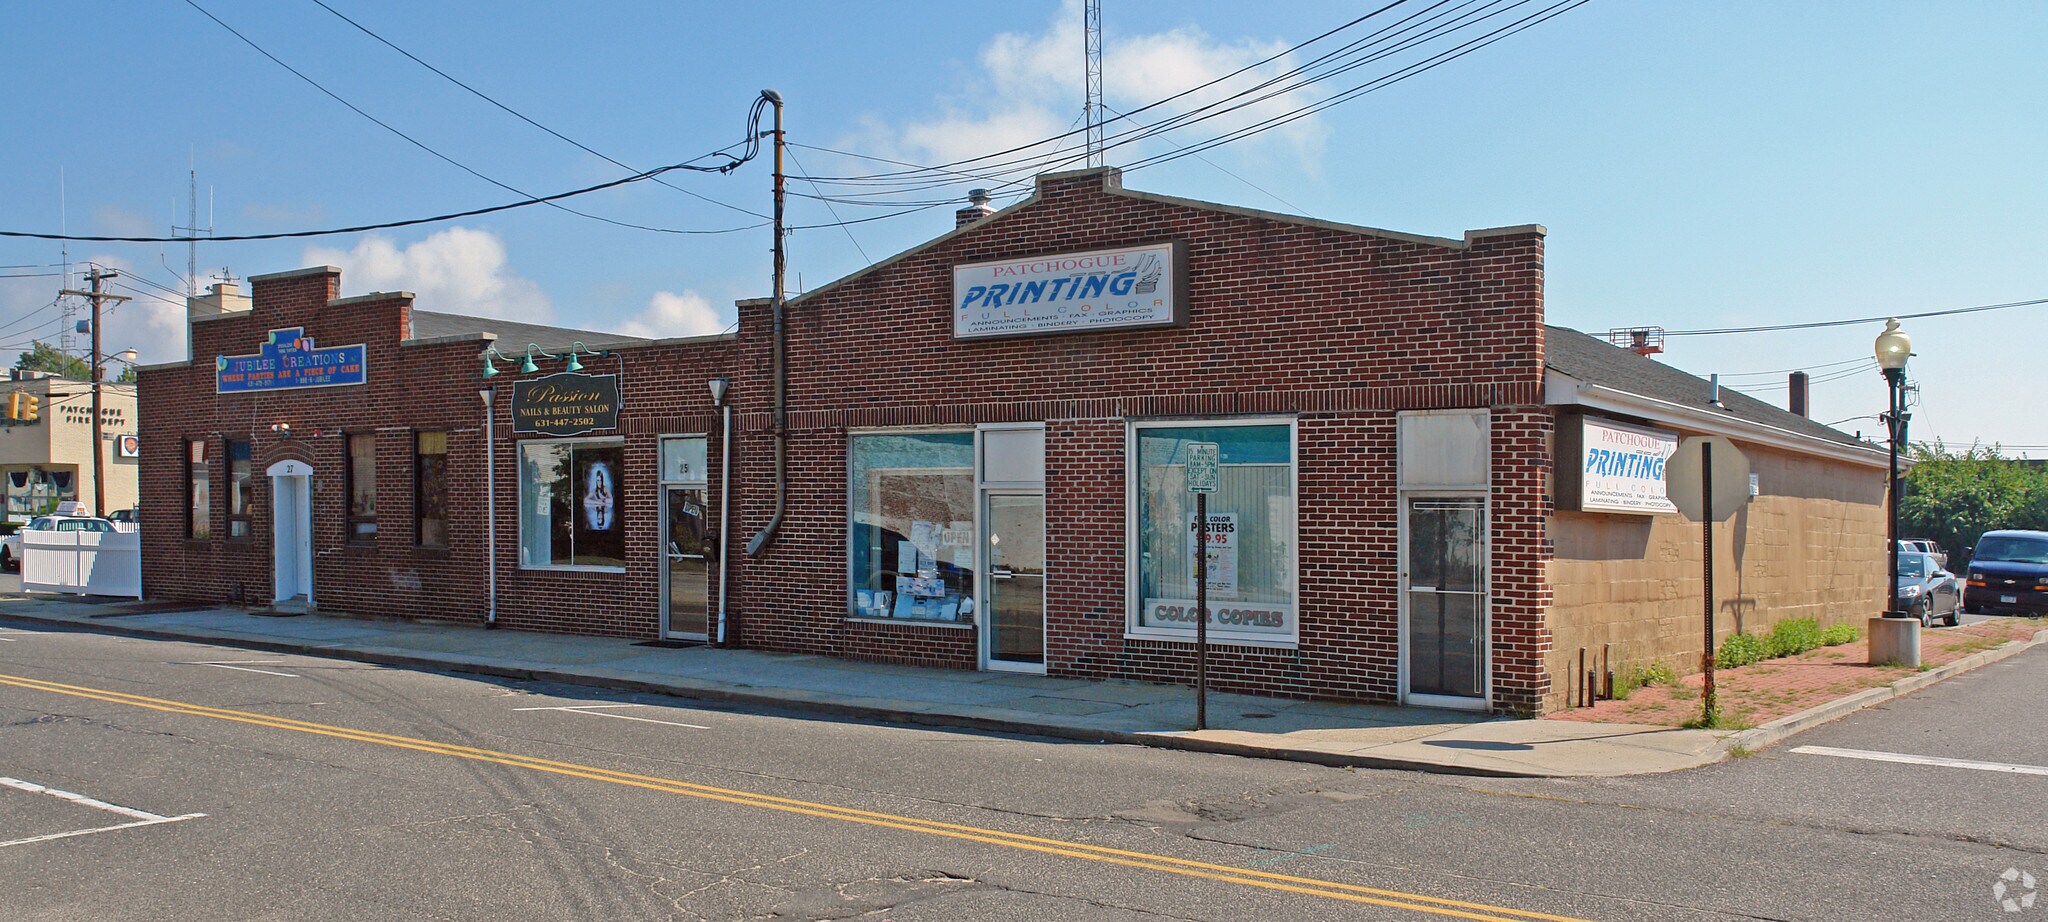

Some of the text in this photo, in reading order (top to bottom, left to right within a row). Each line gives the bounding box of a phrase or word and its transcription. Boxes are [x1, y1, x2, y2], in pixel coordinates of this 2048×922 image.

[993, 254, 1127, 277] PATCHOGUE
[960, 272, 1137, 309] PRINTING
[961, 299, 1163, 321] FULL COLOR
[970, 315, 1059, 326] ANNOUNCEMENTS
[1098, 308, 1153, 317] GRAPHICS
[968, 314, 1154, 333] LAMINATING BINDERY PHOTOCOPY
[235, 359, 276, 372] JUBILEE
[282, 352, 345, 368] CREATIONS
[222, 364, 360, 382] WHERE PARTIES ARE A PIECE OF CAKE
[526, 384, 600, 403] Passion
[60, 405, 123, 417] PATCHGUE
[520, 404, 609, 417] NAILS & BEAUTY SALON
[66, 415, 126, 427] FIRE DEPT
[535, 417, 594, 427] 631-447-2502
[1602, 429, 1661, 449] PATCHOGUE
[287, 464, 294, 473] 27
[680, 463, 689, 473] 25
[1585, 447, 1665, 481] PRINTING
[1585, 480, 1665, 495] FULL COLO
[1591, 490, 1633, 499] ANNOUNCEMENTS
[1191, 523, 1235, 532] PSTERS
[943, 531, 970, 544] OPEN
[1217, 608, 1283, 627] COPIES
